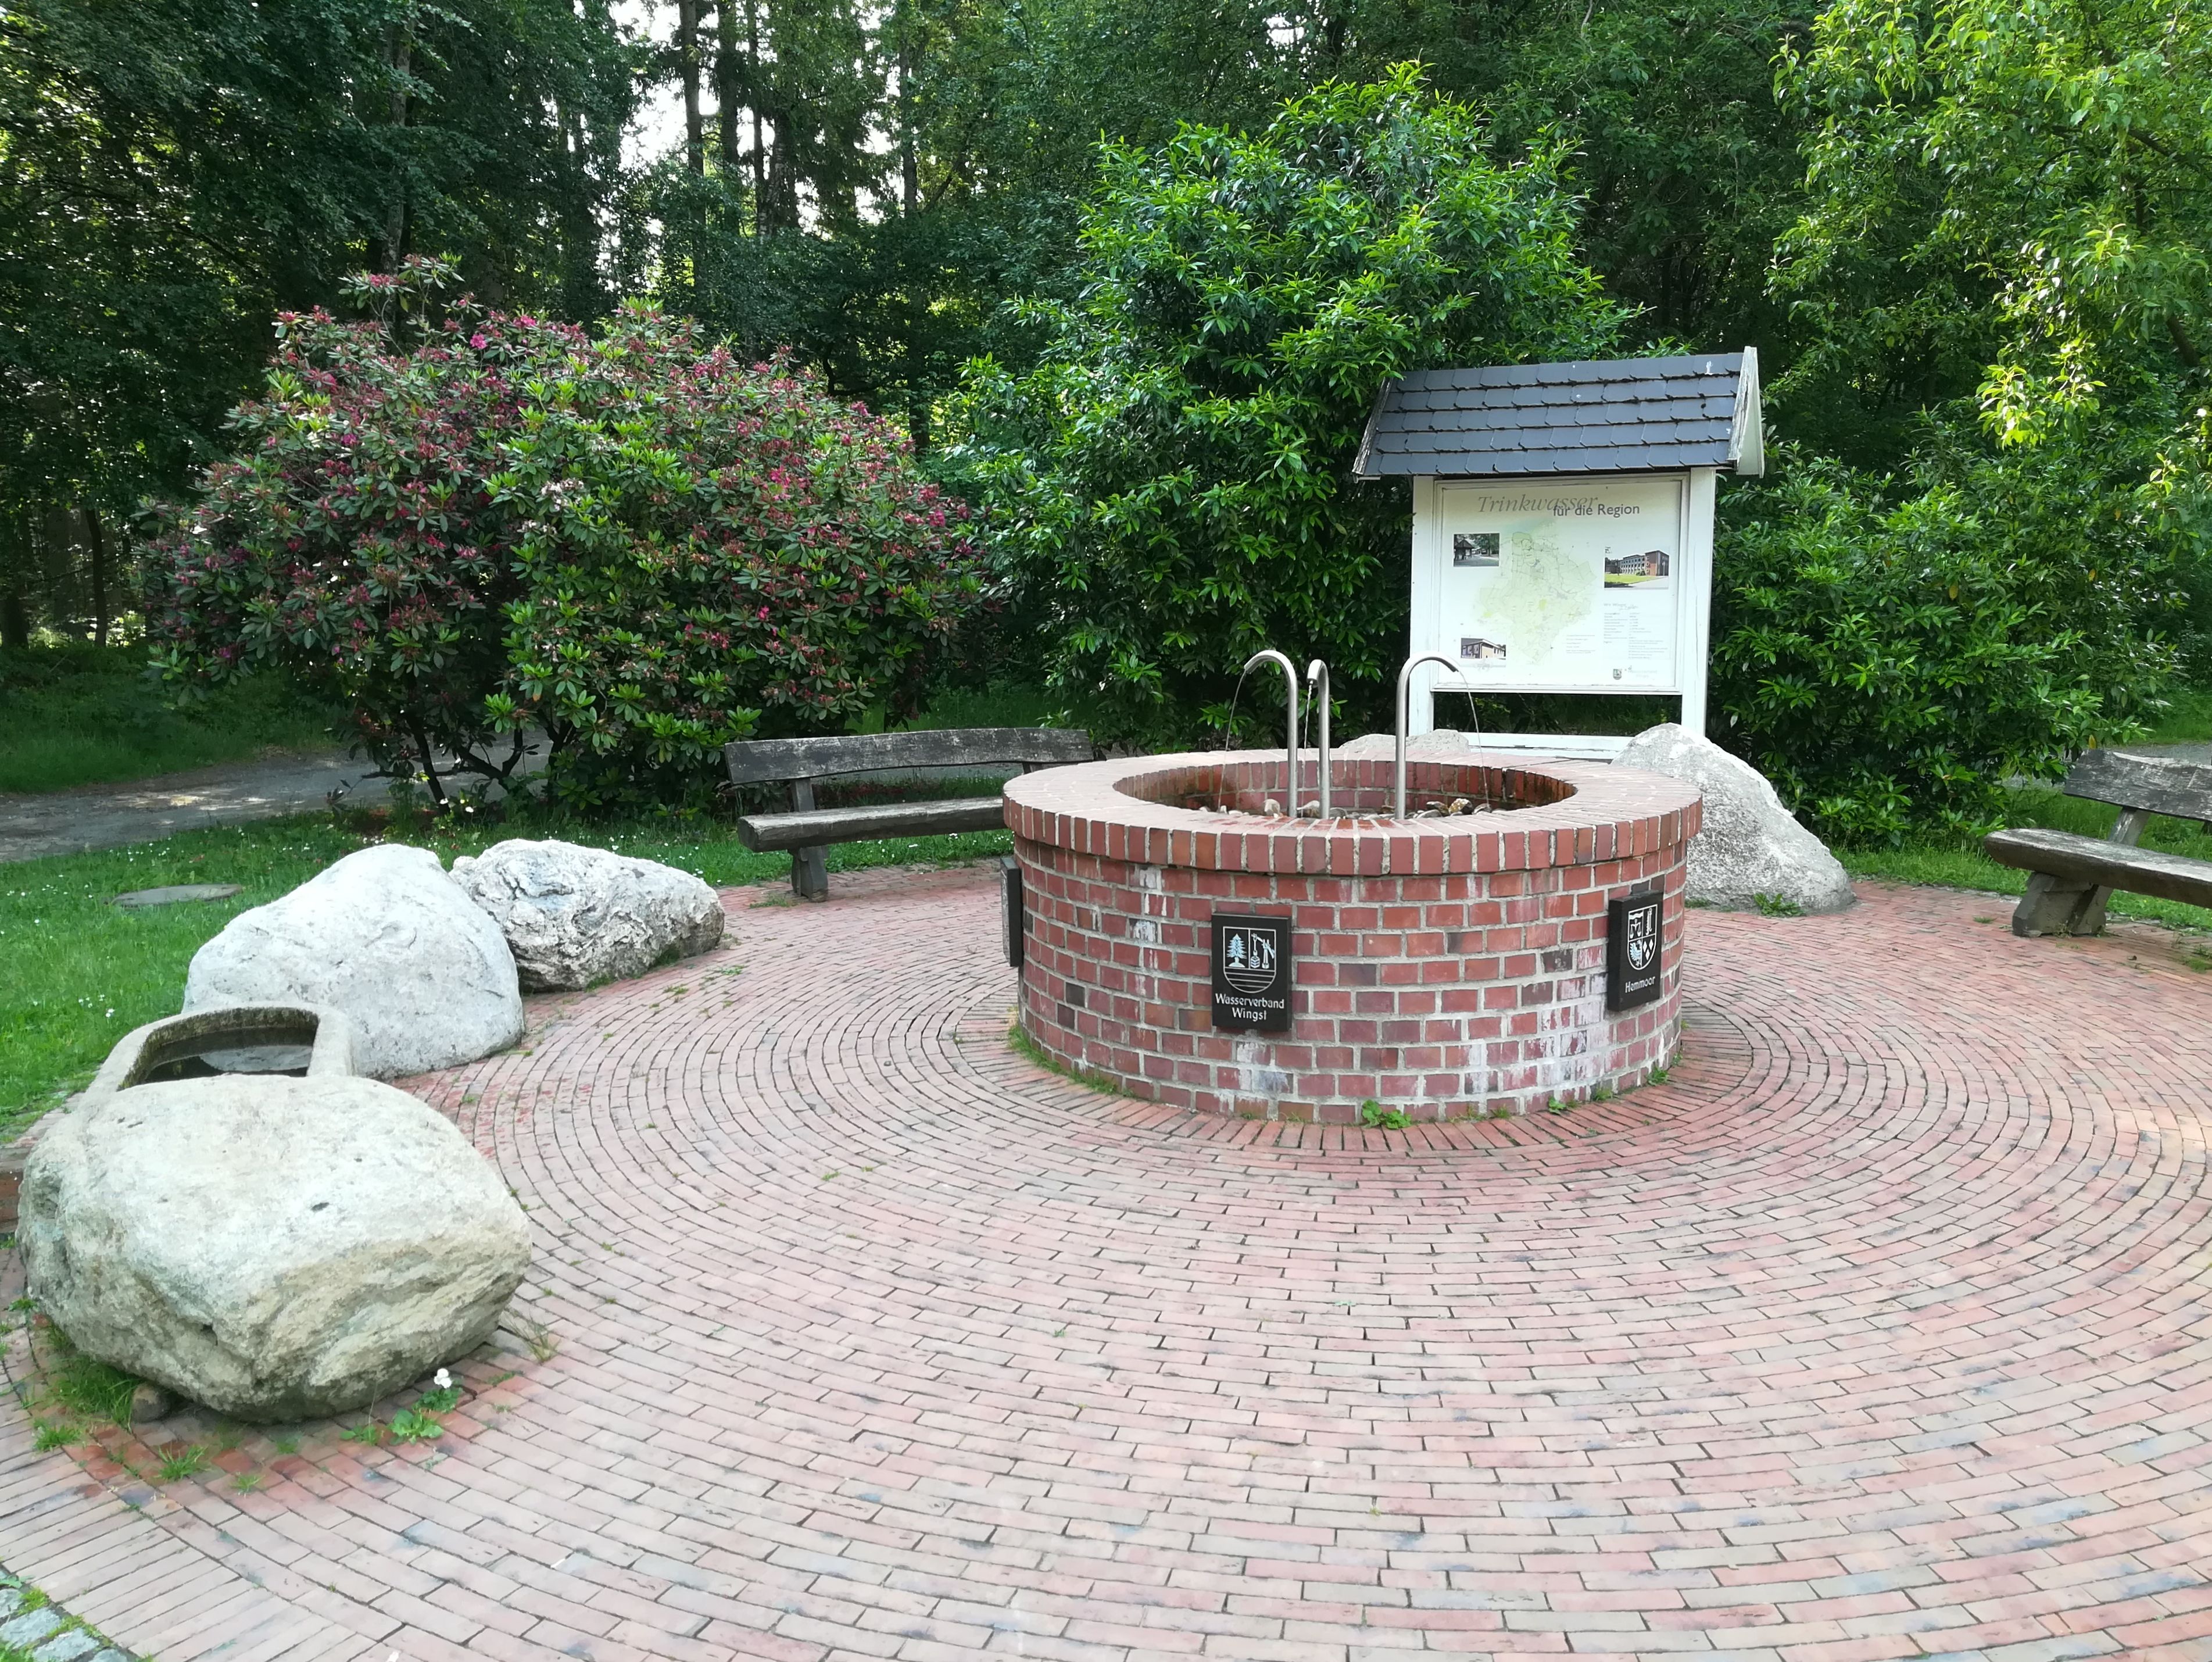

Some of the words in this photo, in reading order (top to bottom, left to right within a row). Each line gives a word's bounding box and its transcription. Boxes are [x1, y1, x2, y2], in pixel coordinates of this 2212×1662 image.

[1478, 494, 1598, 513] Trinkwasser
[1553, 505, 1570, 516] für
[1574, 504, 1593, 516] die
[1598, 503, 1640, 518] Region
[1625, 976, 1655, 993] Hemmoor
[1215, 993, 1284, 1009] Wasserverband
[1232, 1007, 1267, 1022] Wingst
